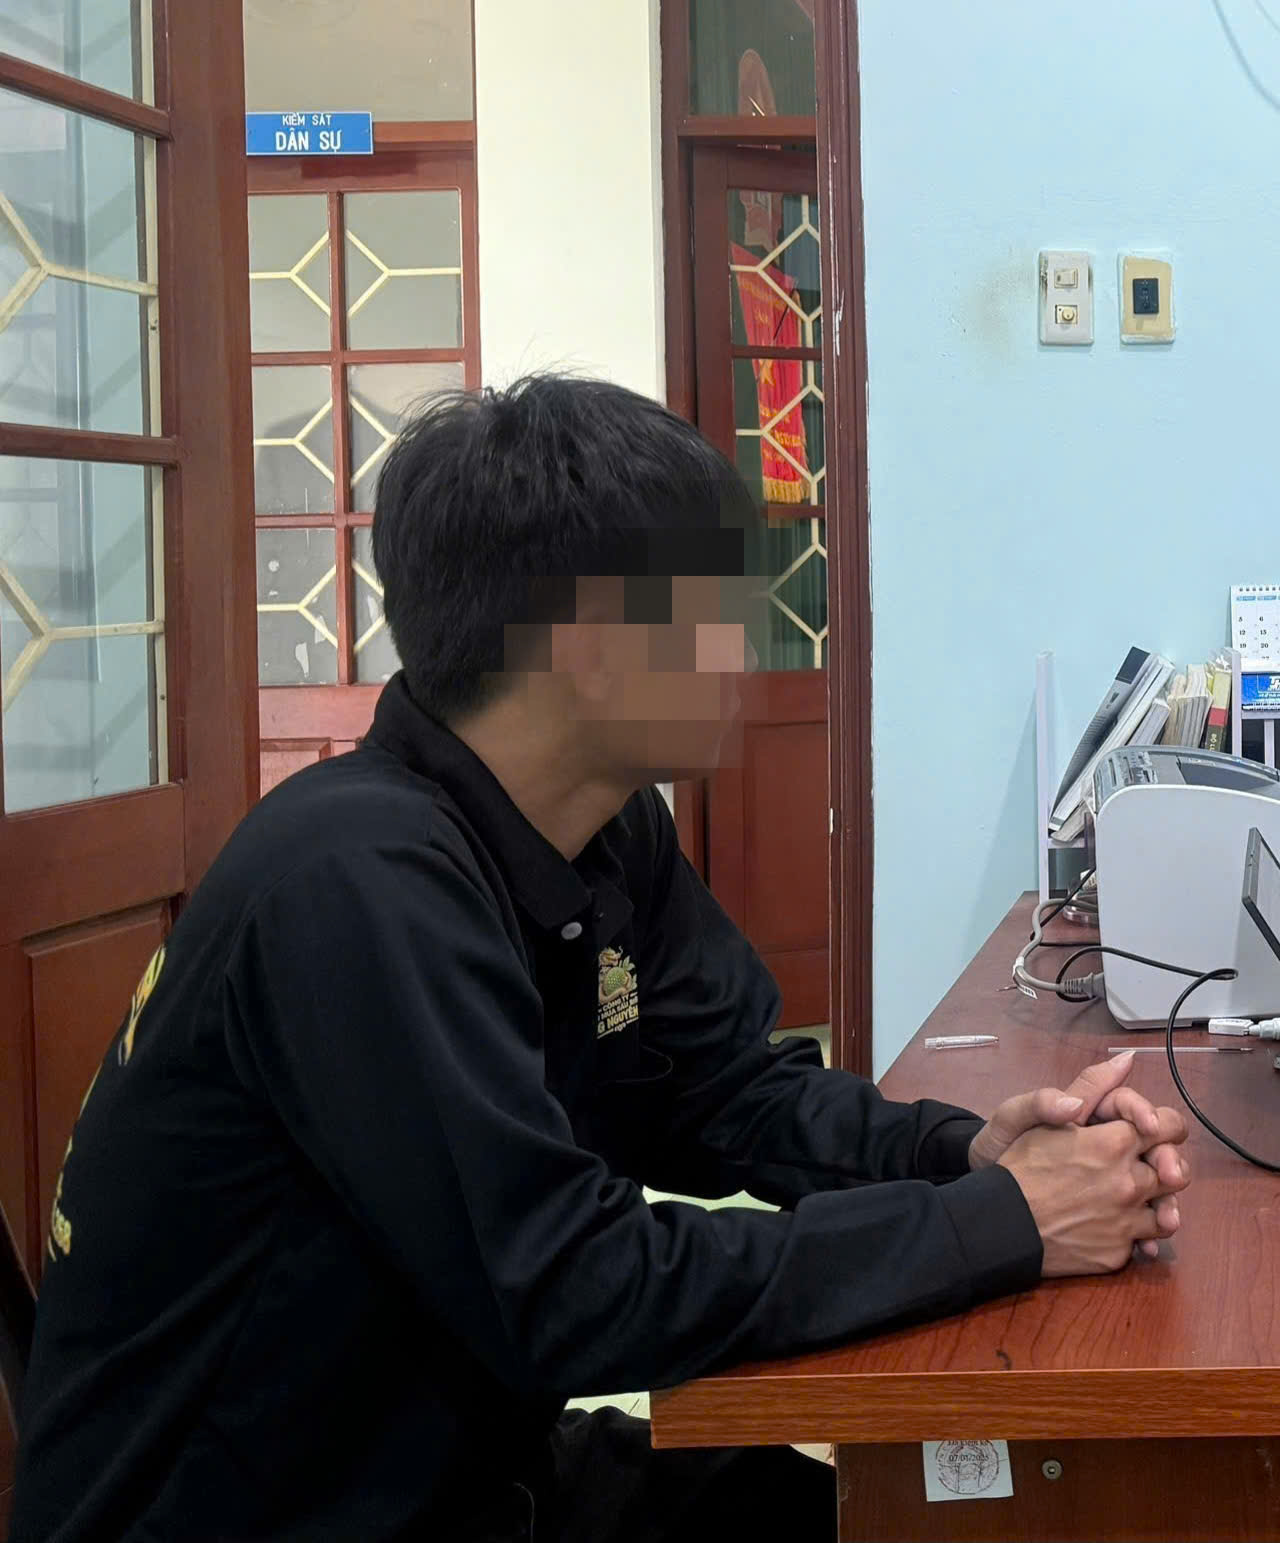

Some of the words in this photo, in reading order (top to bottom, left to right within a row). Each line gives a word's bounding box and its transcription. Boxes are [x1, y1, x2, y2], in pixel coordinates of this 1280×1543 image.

[282, 112, 306, 126] KIỂM
[312, 112, 332, 126] SÁT
[275, 127, 309, 151] DÂN
[319, 129, 342, 153] SỰ
